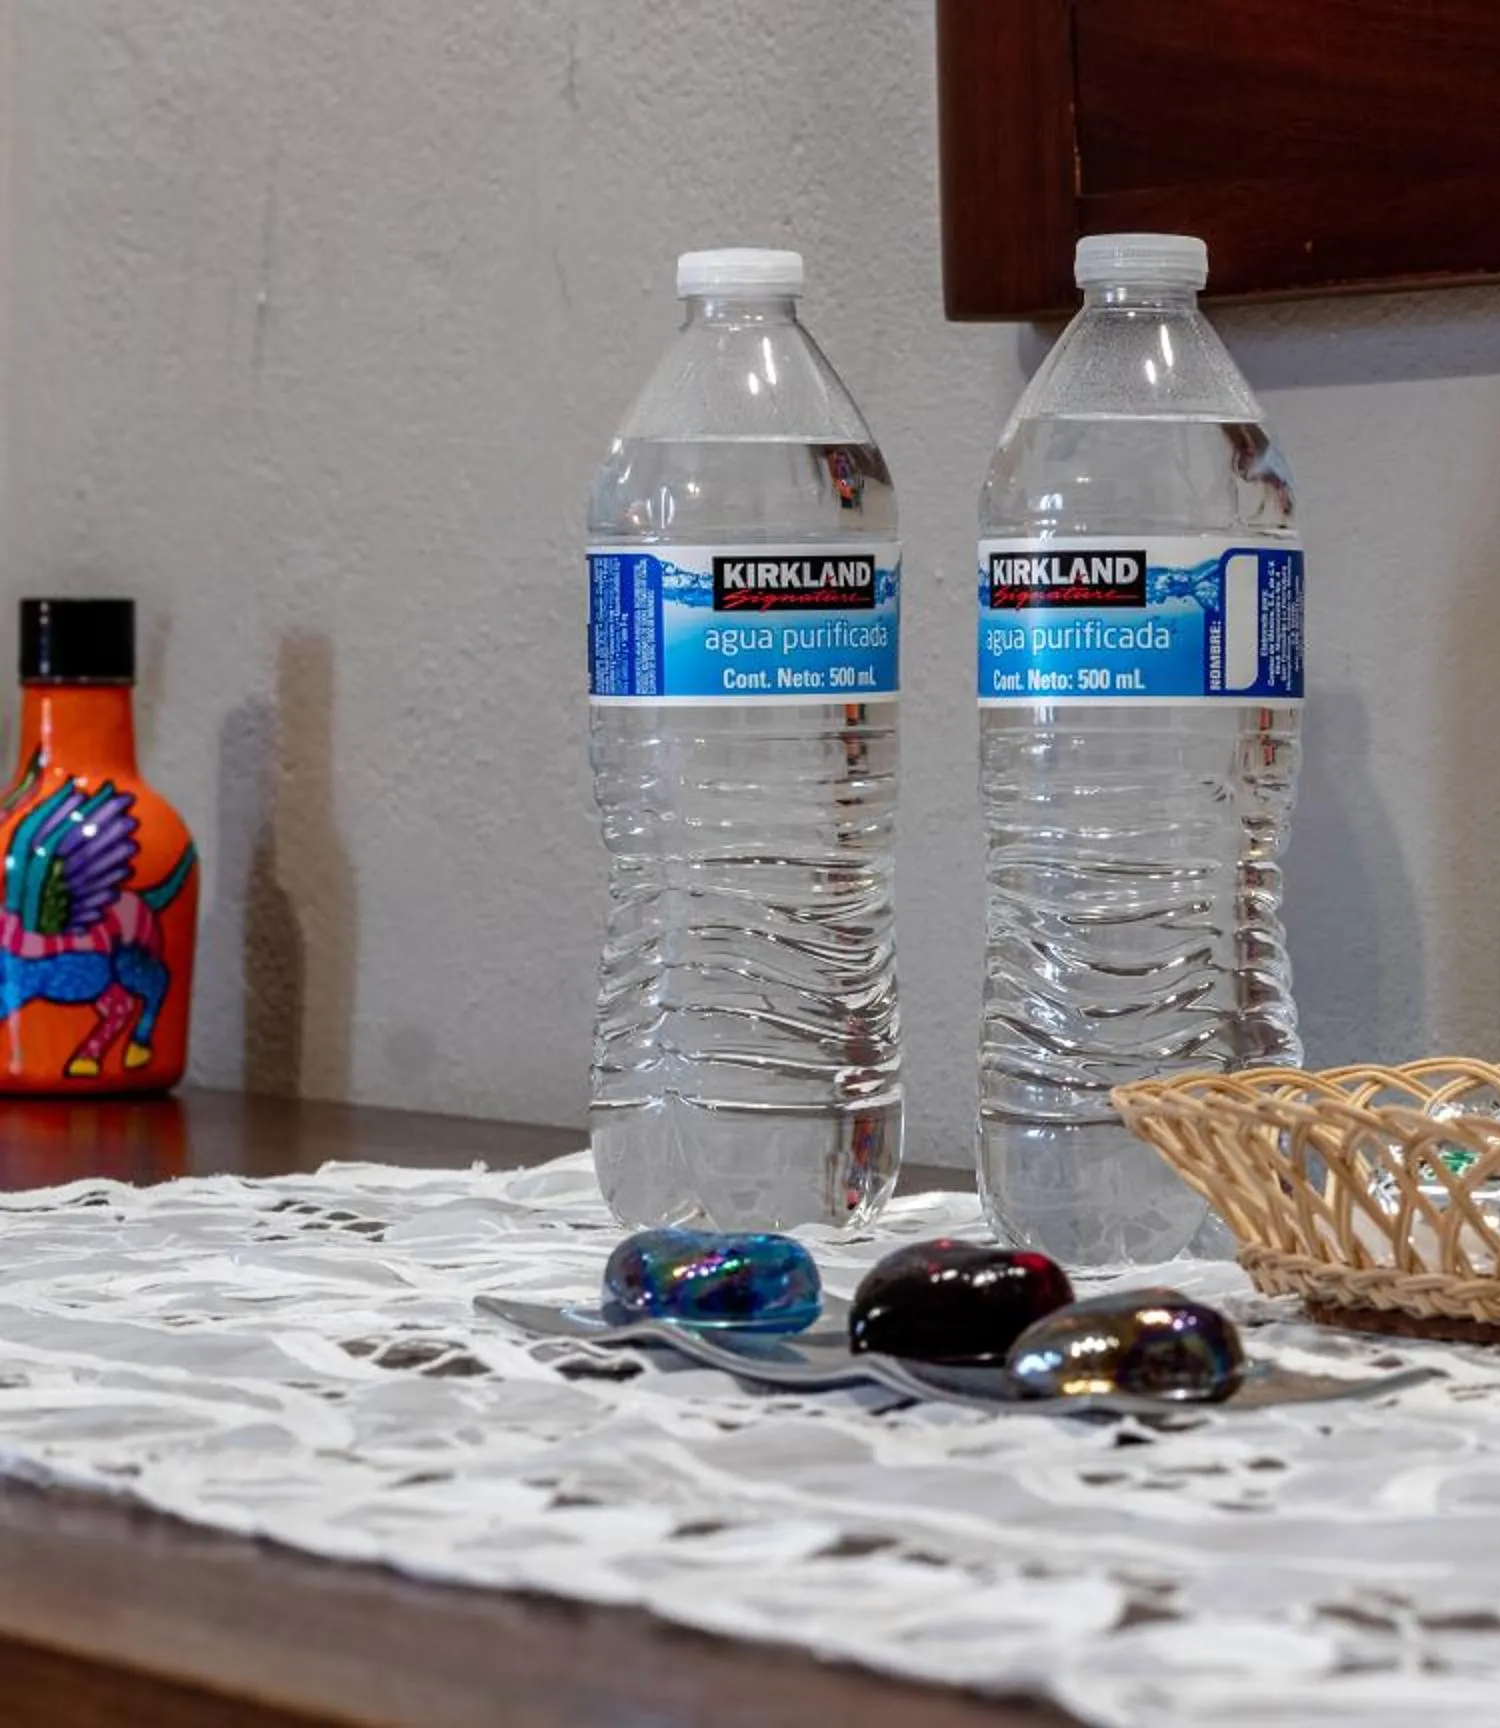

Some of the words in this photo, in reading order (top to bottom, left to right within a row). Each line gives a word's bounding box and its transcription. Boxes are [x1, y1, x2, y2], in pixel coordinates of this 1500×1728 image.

[722, 561, 871, 589] KIRKLAND
[992, 557, 1140, 586] KIRKLAND
[704, 627, 773, 656] agua
[782, 620, 888, 655] purificada
[986, 628, 1025, 657] agua
[1032, 621, 1171, 656] purificada
[1208, 620, 1222, 691] NOMBRE:
[723, 667, 772, 689] Cont.
[777, 667, 826, 688] Neto:
[829, 666, 856, 687] 500
[857, 665, 877, 686] mL
[992, 668, 1025, 691] Cont.
[1027, 668, 1074, 690] Neto:
[1077, 667, 1111, 690] 500
[1115, 668, 1146, 690] mL
